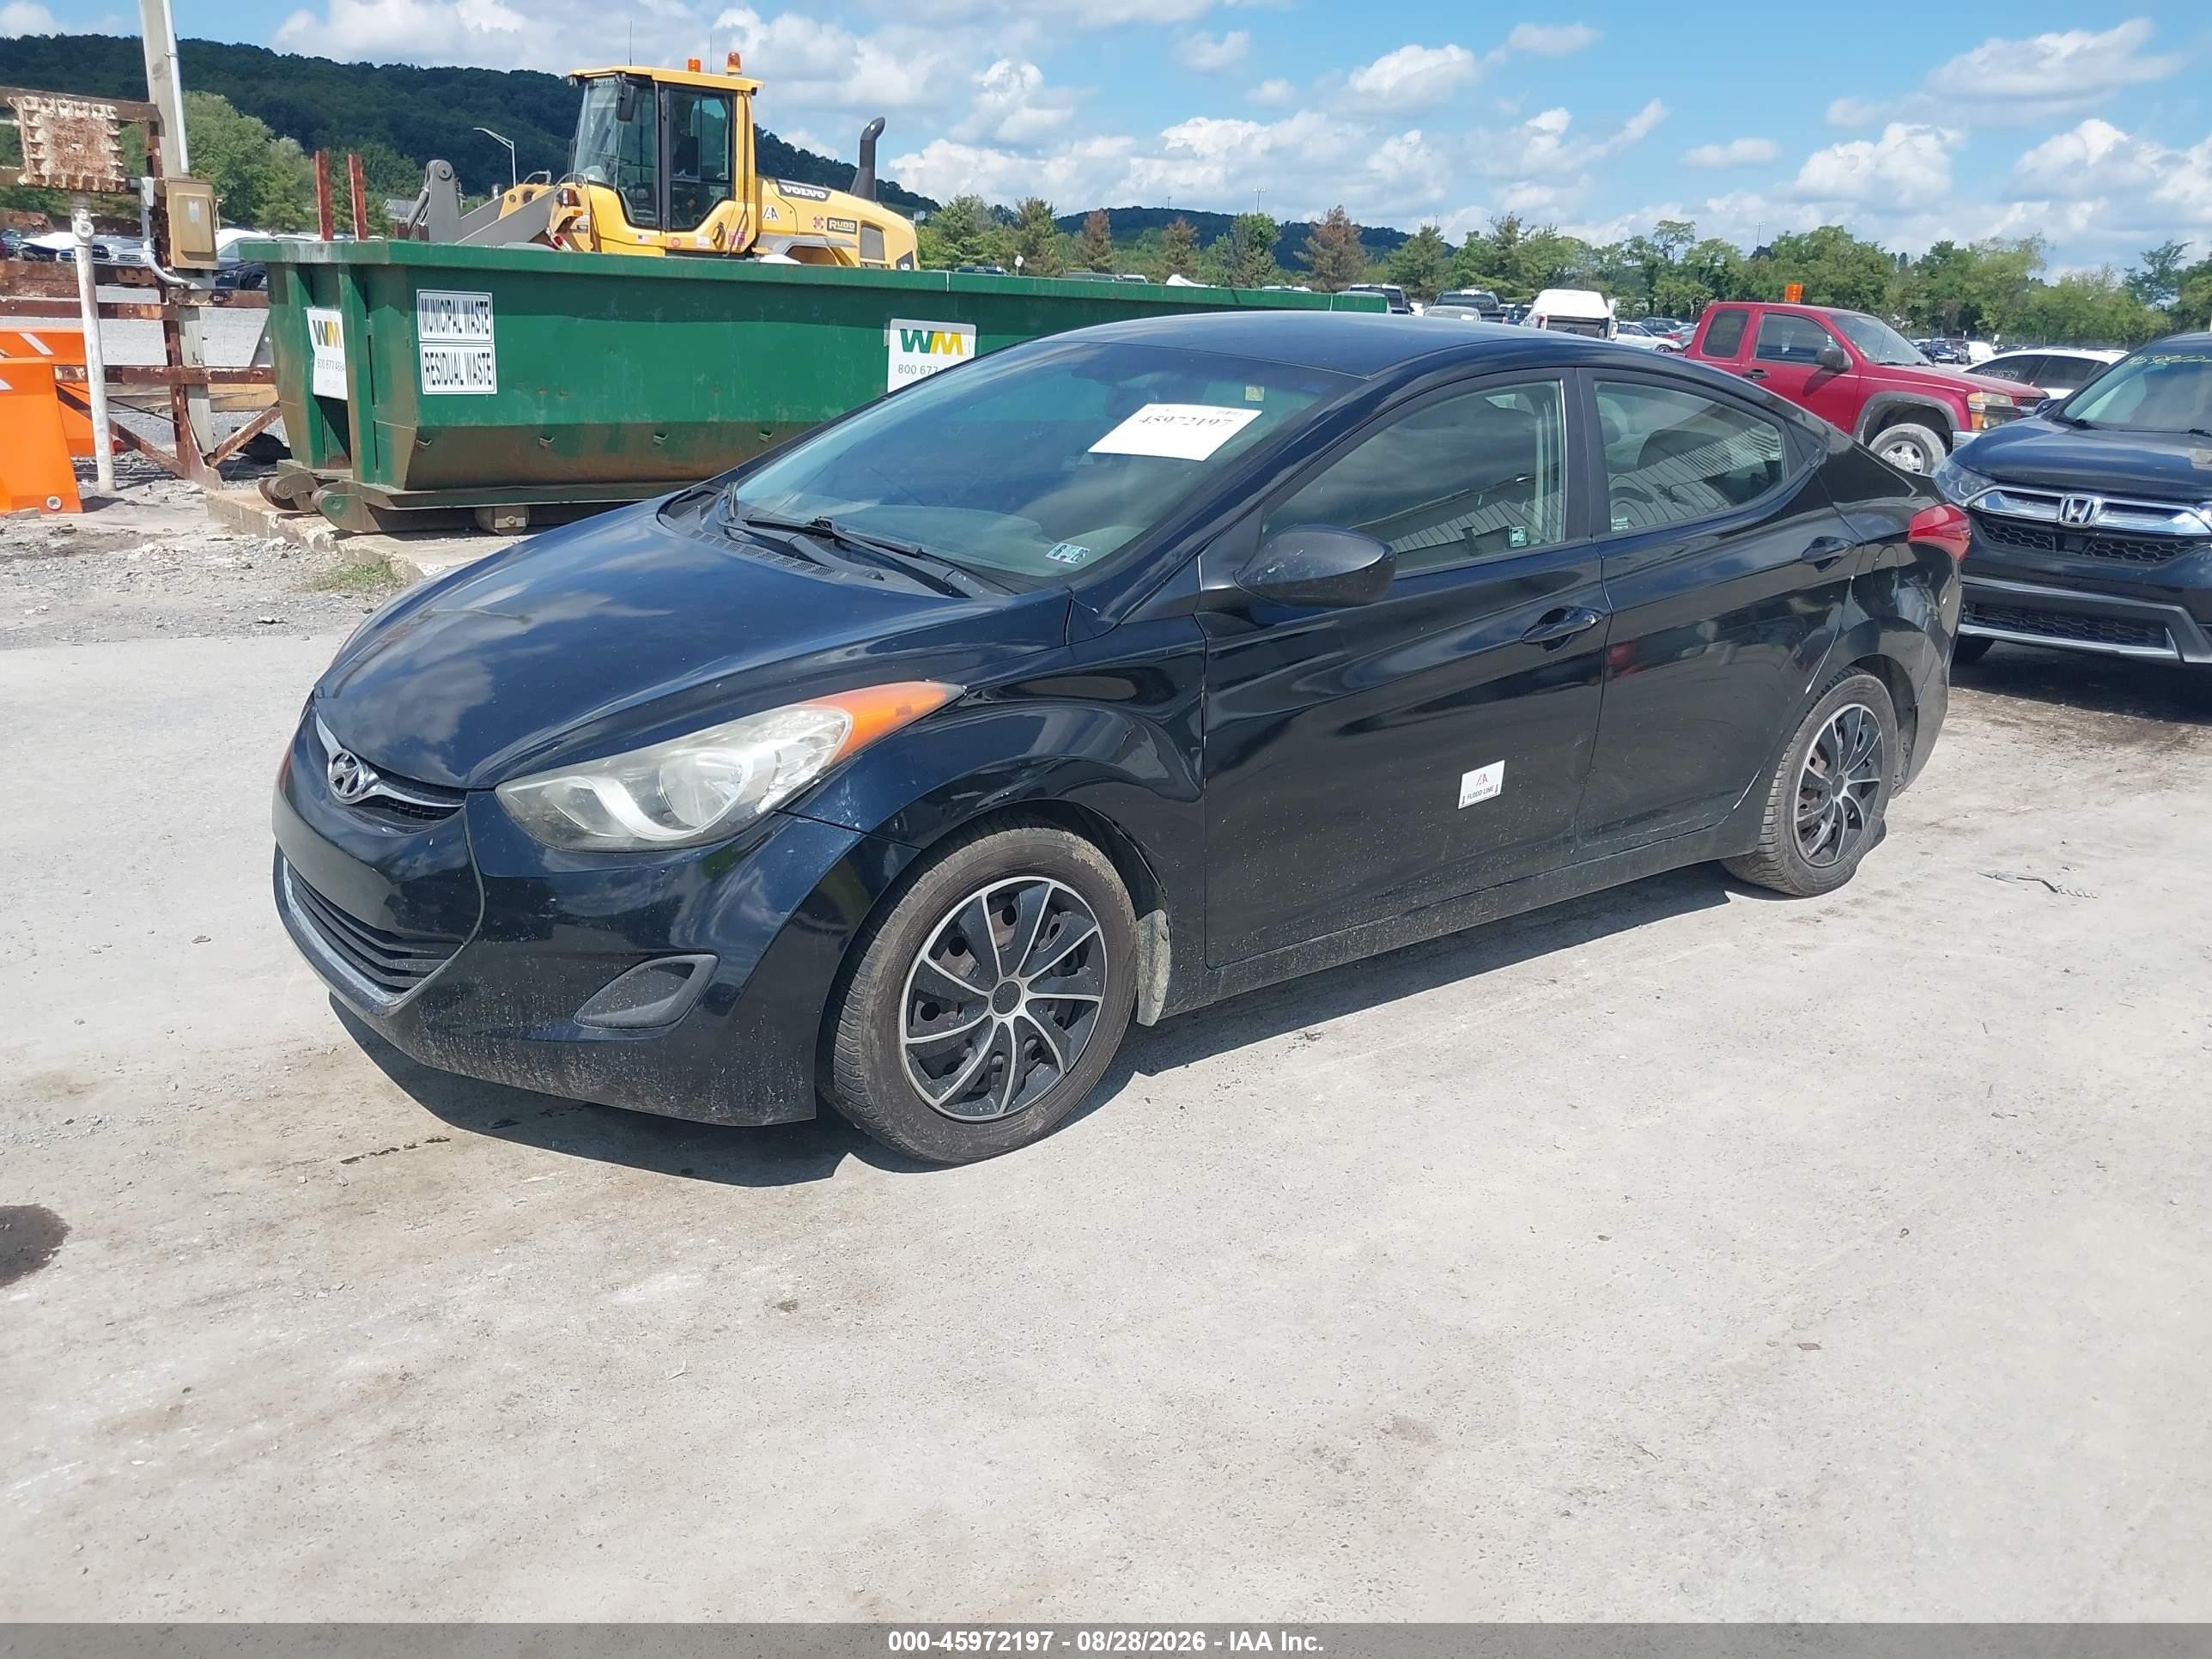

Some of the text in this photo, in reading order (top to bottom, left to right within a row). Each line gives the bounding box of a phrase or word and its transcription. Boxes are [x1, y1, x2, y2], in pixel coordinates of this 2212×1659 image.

[781, 185, 827, 198] VOLVO
[829, 219, 855, 229] RUDD
[421, 298, 489, 335] MUNICIPAL WASTE
[312, 319, 343, 349] WM
[900, 329, 963, 356] WM
[424, 352, 492, 386] RESIDUAL WASTE
[898, 364, 939, 375] 800 677
